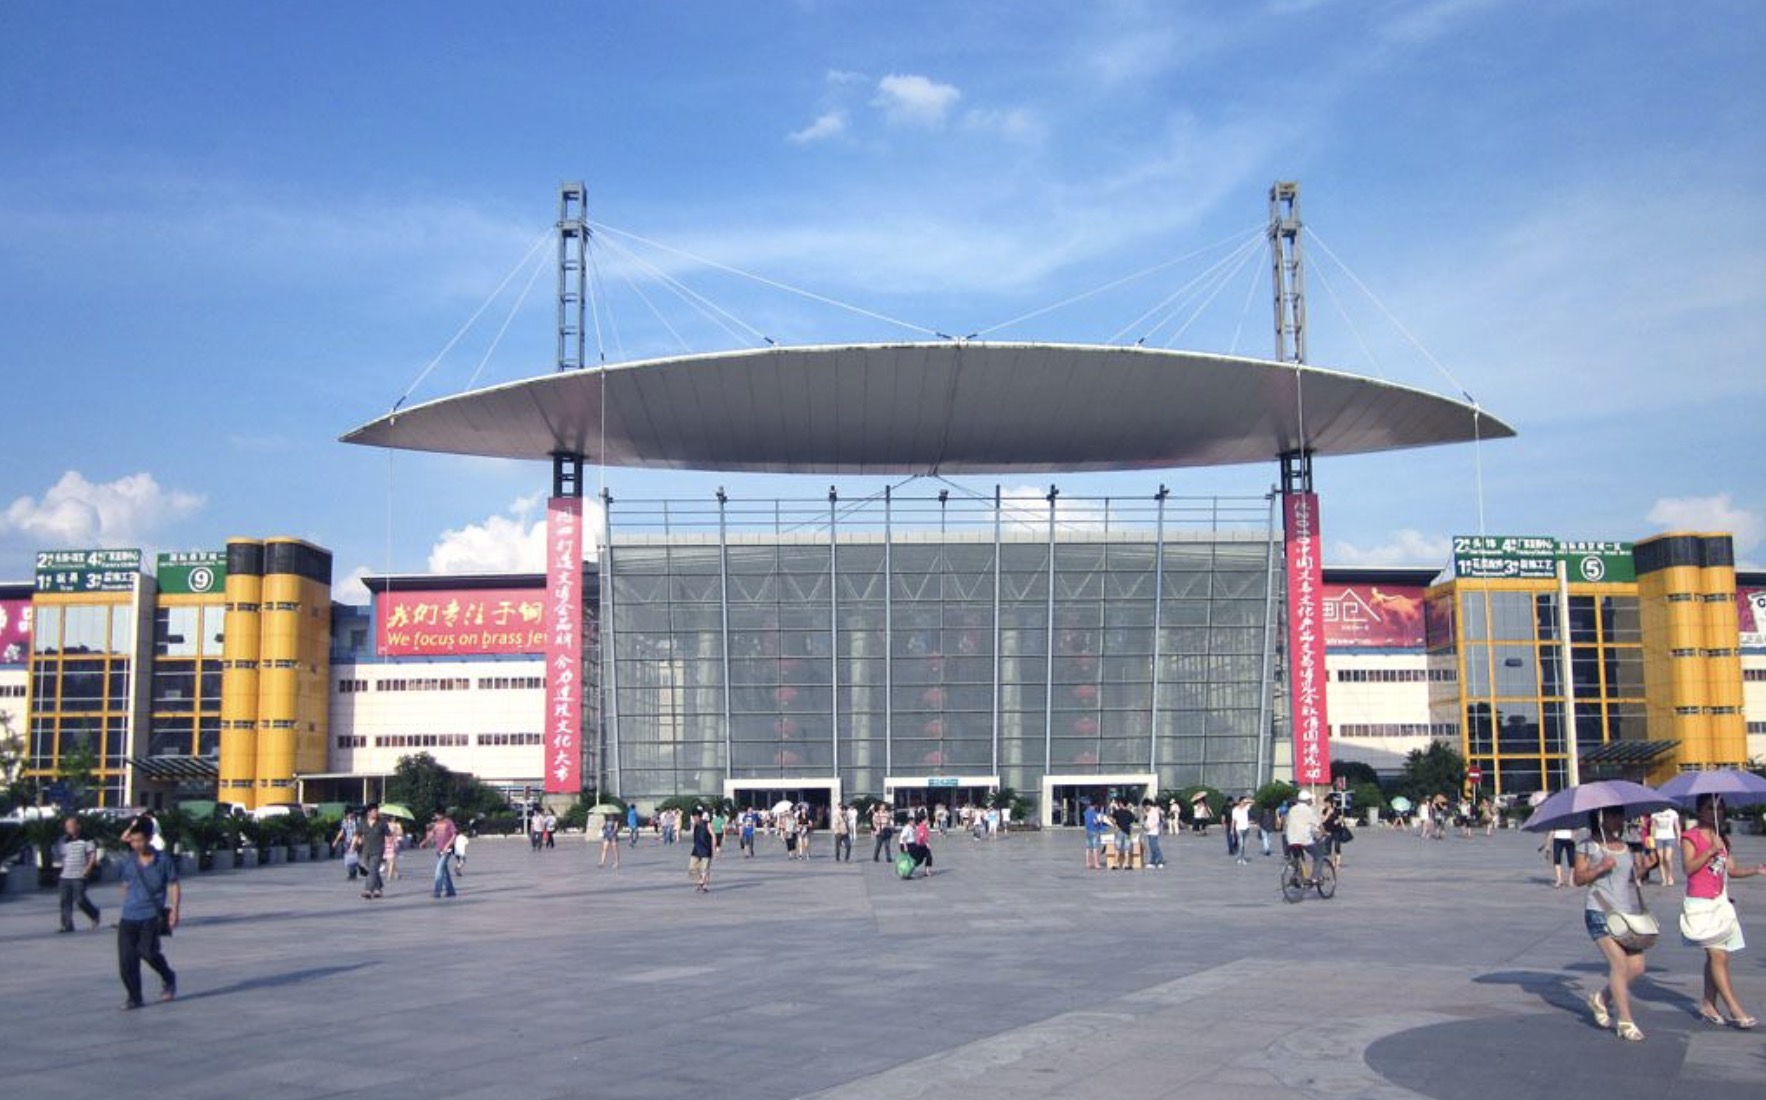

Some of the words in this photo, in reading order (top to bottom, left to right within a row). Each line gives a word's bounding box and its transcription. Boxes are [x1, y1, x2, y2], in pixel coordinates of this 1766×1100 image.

[193, 568, 209, 589] 9
[1585, 561, 1600, 578] 5
[387, 631, 410, 646] We
[413, 631, 455, 650] focus
[458, 632, 478, 645] on
[482, 629, 523, 648] brass
[526, 629, 547, 648] je
